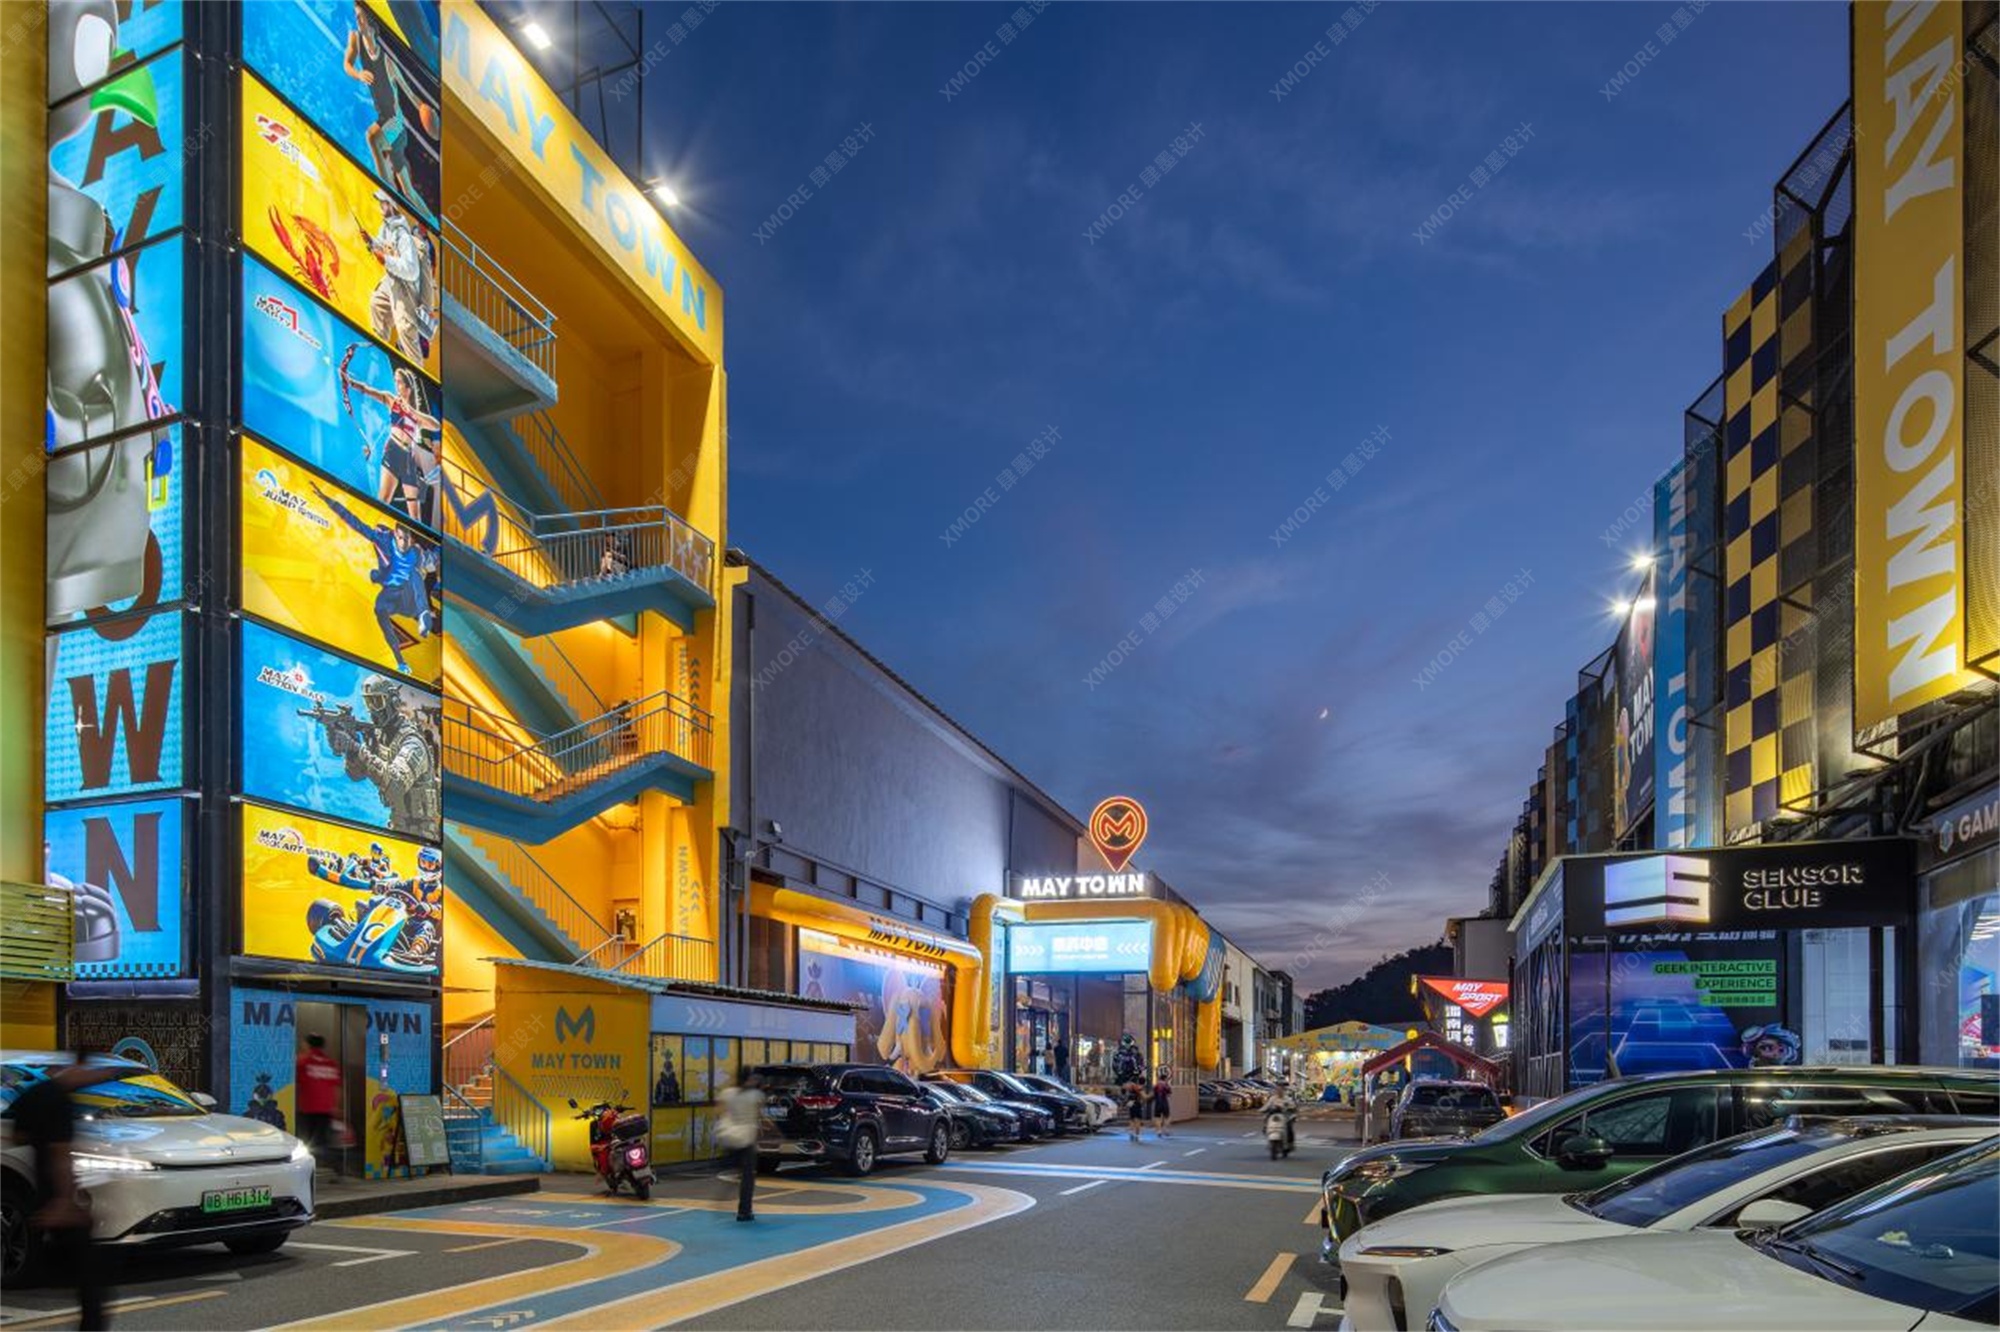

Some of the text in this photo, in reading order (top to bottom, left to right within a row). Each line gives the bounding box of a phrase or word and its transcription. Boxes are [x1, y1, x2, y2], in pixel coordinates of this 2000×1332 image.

[570, 140, 706, 332] TOWN
[1884, 254, 1957, 704] TOWN
[1021, 873, 1145, 898] MAY TOWN
[1742, 864, 1863, 889] SENSOR
[1655, 961, 1773, 975] GEEK INTERACTIVE
[1452, 982, 1483, 992] MAY
[1696, 978, 1774, 989] EXPERIENCE
[531, 1053, 621, 1070] MAY TOWN
